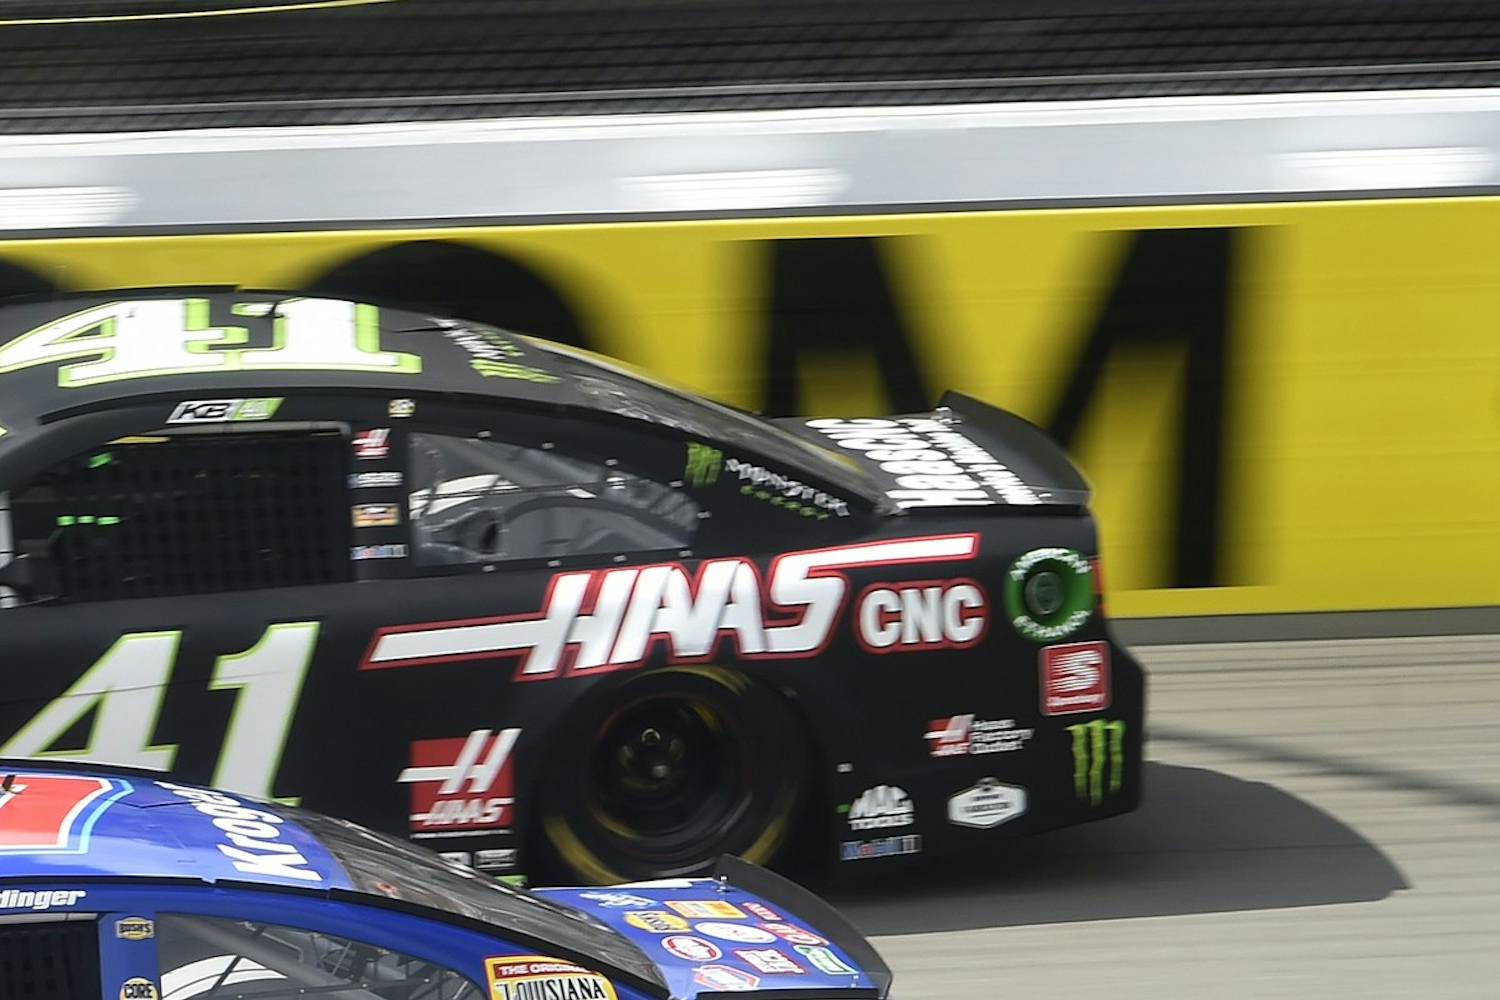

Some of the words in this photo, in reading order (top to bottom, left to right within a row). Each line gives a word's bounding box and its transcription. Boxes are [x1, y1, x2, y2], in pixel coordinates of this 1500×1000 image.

[357, 533, 981, 682] HAAS
[859, 585, 985, 648] CNC
[154, 780, 323, 881] Kroger
[409, 798, 514, 825] HAAS
[124, 984, 153, 998] CORE
[499, 965, 529, 976] THE
